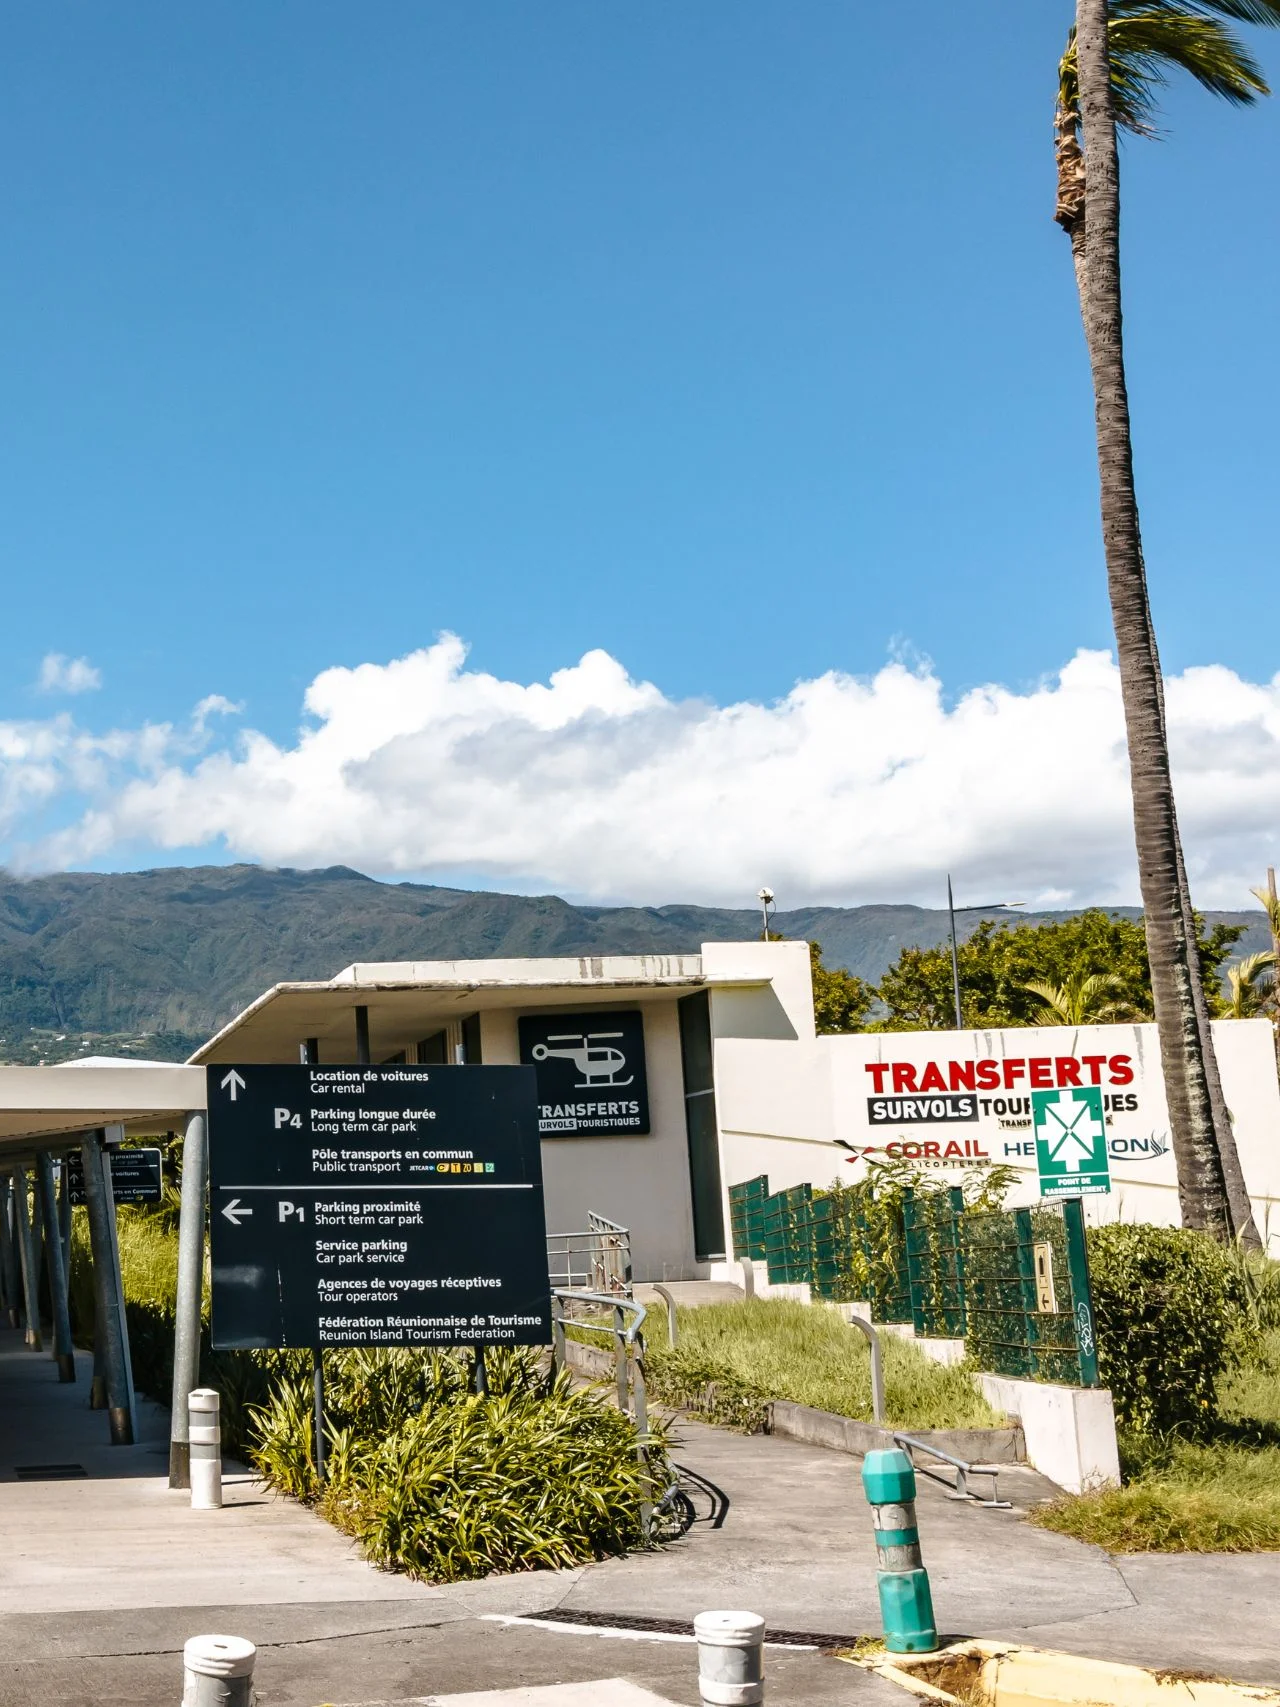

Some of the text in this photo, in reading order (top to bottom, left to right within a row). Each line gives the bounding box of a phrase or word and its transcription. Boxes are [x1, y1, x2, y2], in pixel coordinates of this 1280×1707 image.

[309, 1070, 429, 1082] Location de voitures
[865, 1054, 1135, 1093] TRANSFERTS
[310, 1082, 366, 1094] Car rental
[310, 1108, 437, 1121] Parking longue durée
[538, 1101, 640, 1118] RANSFERTS
[872, 1099, 973, 1120] SURVOLS
[274, 1107, 303, 1129] P4
[540, 1118, 640, 1129] URVOLS TOURISTIQUES
[311, 1120, 417, 1134] Long term car park
[311, 1148, 474, 1161] Pôle transports en commun
[885, 1140, 989, 1159] CORAIL
[312, 1160, 347, 1172] Public
[348, 1161, 401, 1174] transport
[1057, 1177, 1092, 1186] POINT DE
[278, 1201, 305, 1223] P1
[314, 1200, 422, 1215] Parking proximité
[314, 1213, 424, 1226] Short term car park
[315, 1239, 408, 1253] Service parking
[315, 1251, 405, 1265] Car park service
[317, 1276, 502, 1291] Agences de voyages réceptives
[317, 1291, 399, 1304] Tour operators
[318, 1314, 542, 1328] Fédération Réunionnaise de Tourisme
[319, 1327, 516, 1341] Reunion Island Tourism Federation
